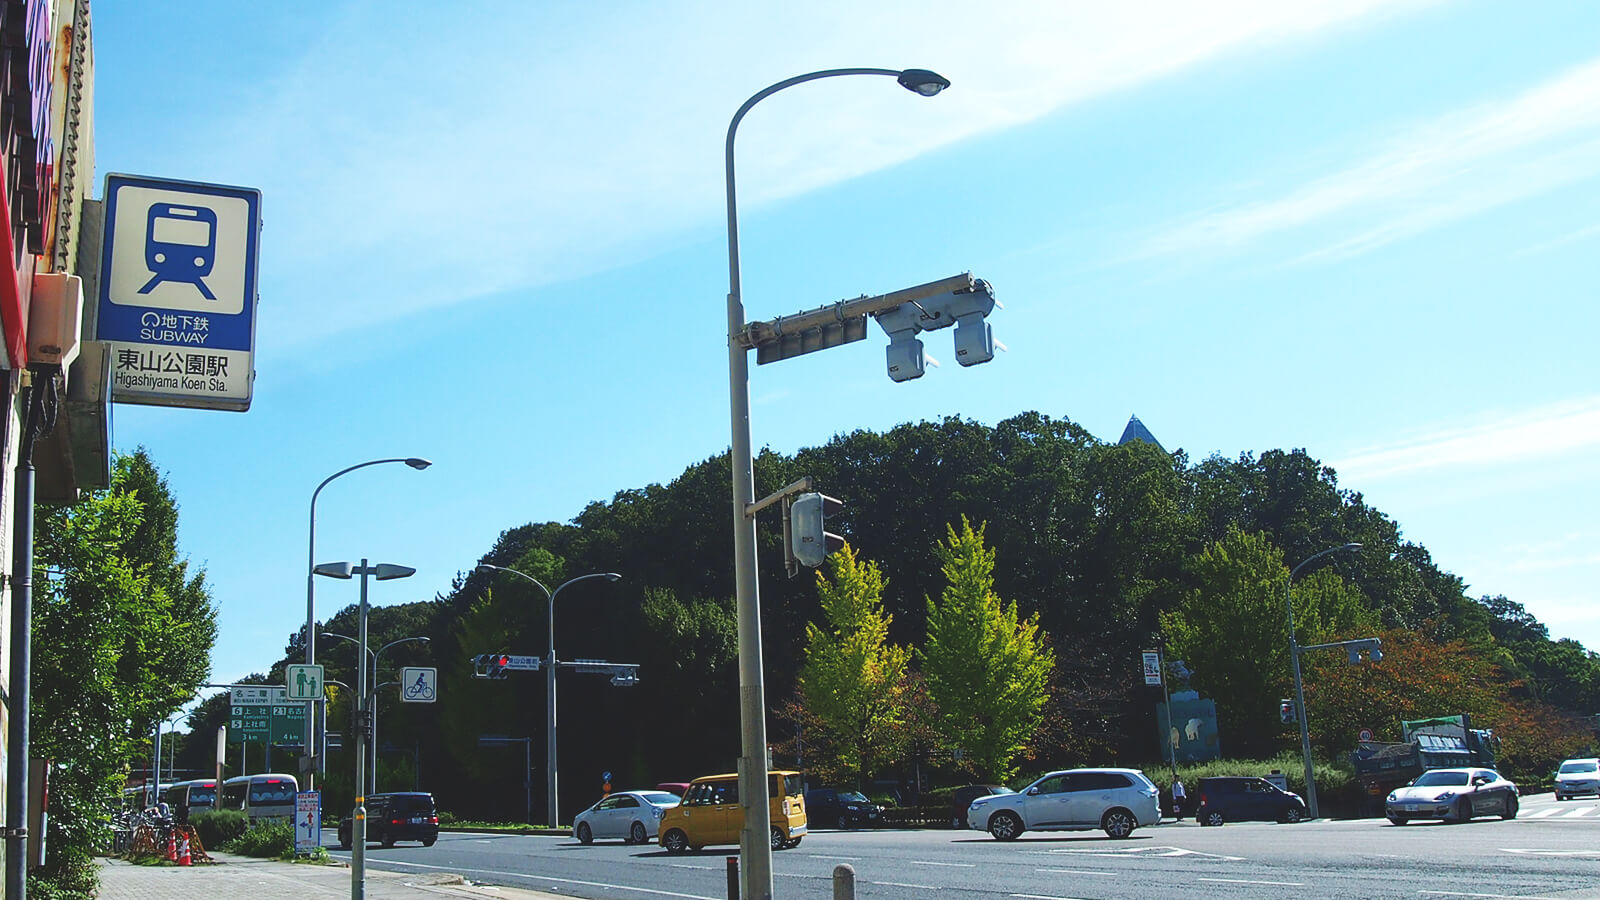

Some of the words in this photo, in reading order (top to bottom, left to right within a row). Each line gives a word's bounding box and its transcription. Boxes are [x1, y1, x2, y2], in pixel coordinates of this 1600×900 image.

[162, 314, 209, 331] 地下鉄
[140, 328, 208, 344] SUBWAY
[117, 349, 228, 377] 東山公園駅
[115, 371, 178, 390] Higashiyama
[181, 376, 206, 390] Koen
[208, 378, 228, 391] Sta.
